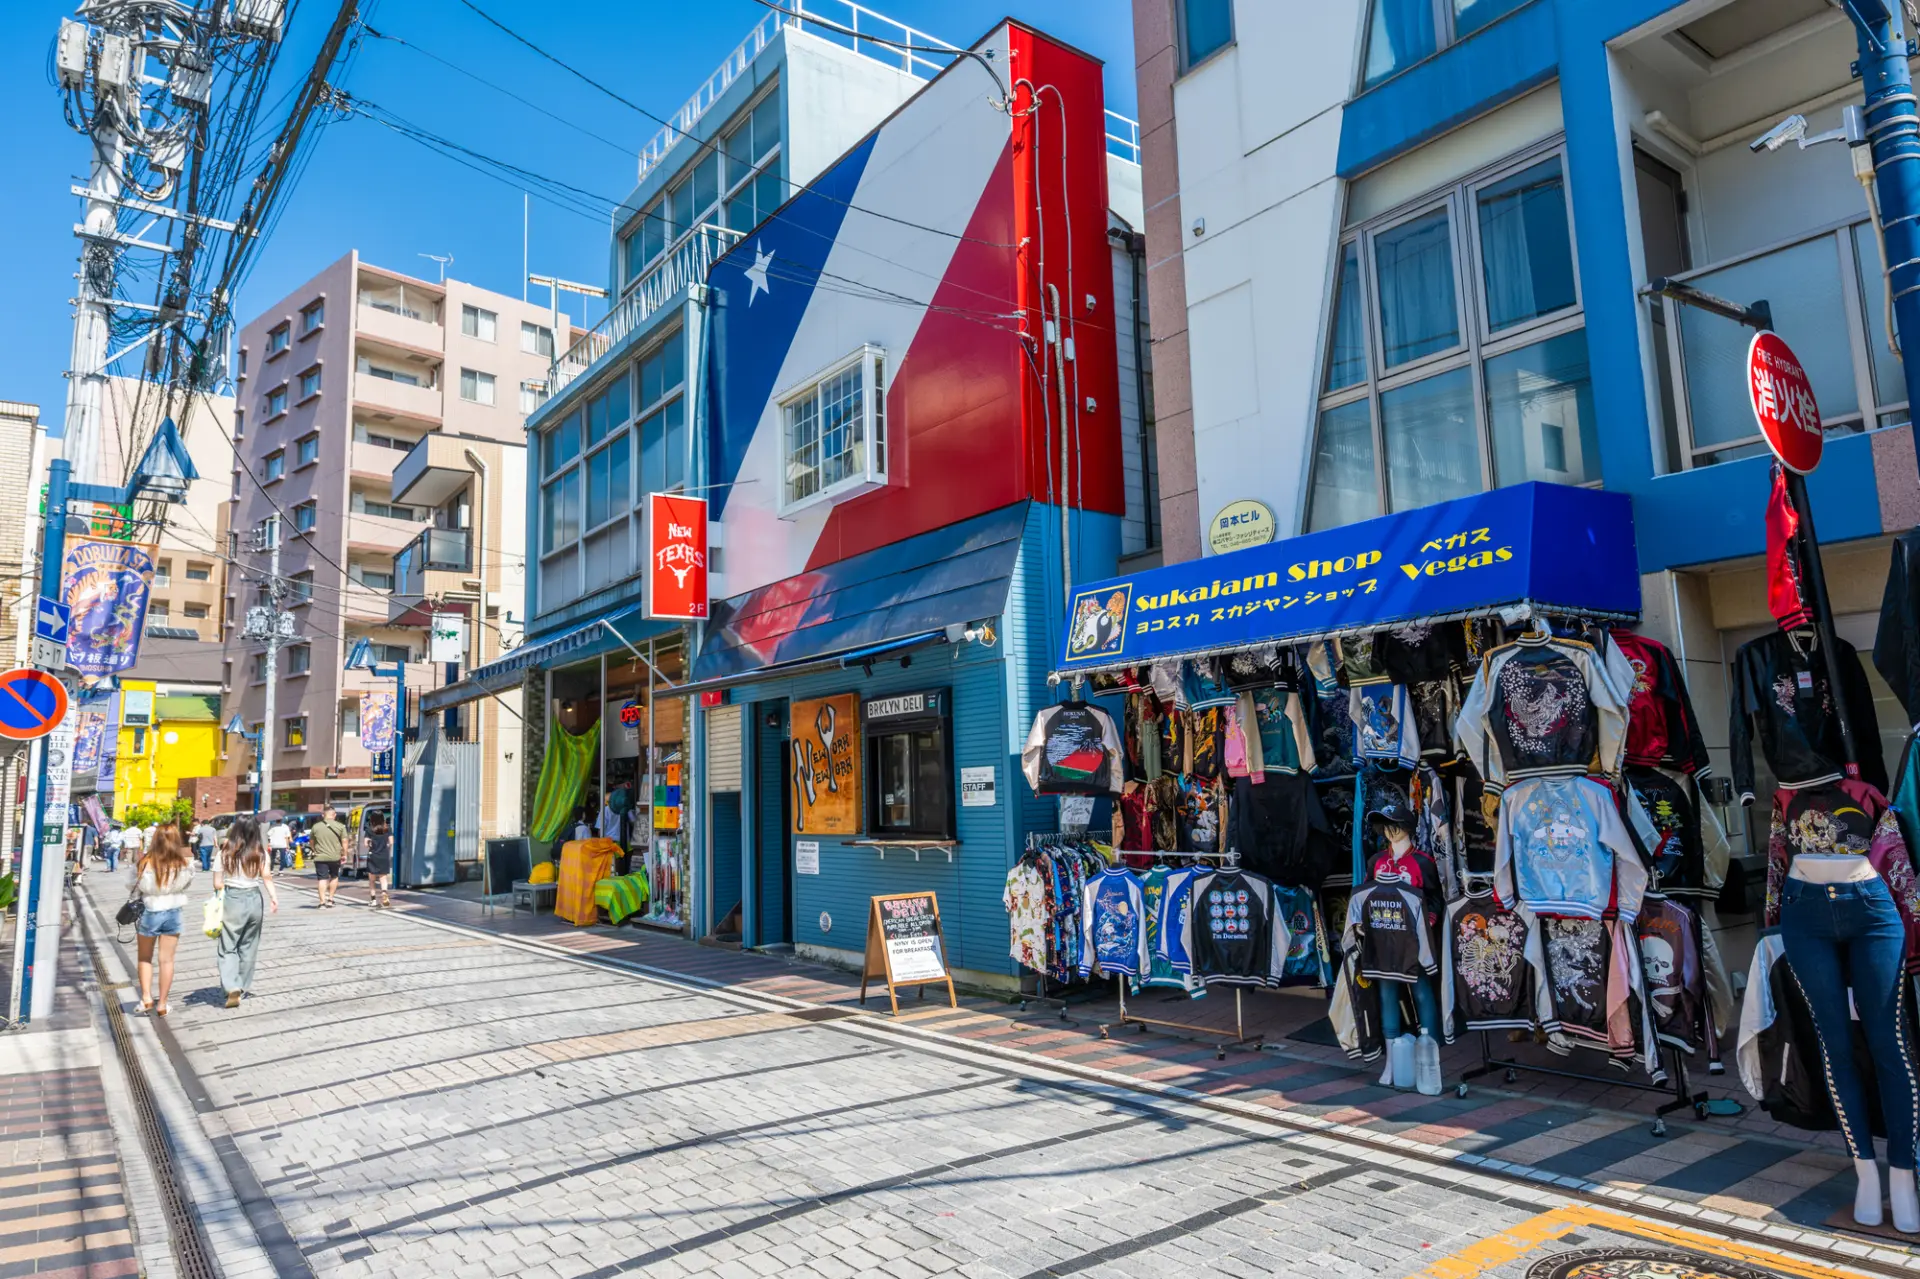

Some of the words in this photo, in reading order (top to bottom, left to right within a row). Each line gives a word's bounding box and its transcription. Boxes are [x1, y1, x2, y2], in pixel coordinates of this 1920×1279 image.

[1756, 347, 1773, 366] FIRE
[1774, 355, 1803, 380] HYDRANT
[1753, 366, 1821, 436] 消火栓
[1219, 510, 1260, 530] 岡本ビル
[1420, 527, 1492, 553] ベガス
[74, 544, 129, 566] DOBUITA
[130, 551, 149, 570] ST
[656, 543, 704, 571] TEXAS
[1399, 545, 1513, 581] Vegas
[1135, 571, 1278, 613] Sukajam
[1287, 549, 1383, 583] Shop
[689, 602, 704, 614] 2F
[1136, 612, 1200, 635] ヨコスカ
[868, 700, 901, 718] BRKLYN
[903, 696, 923, 711] DELI
[963, 782, 986, 791] STAFF
[1370, 900, 1402, 908] MINION
